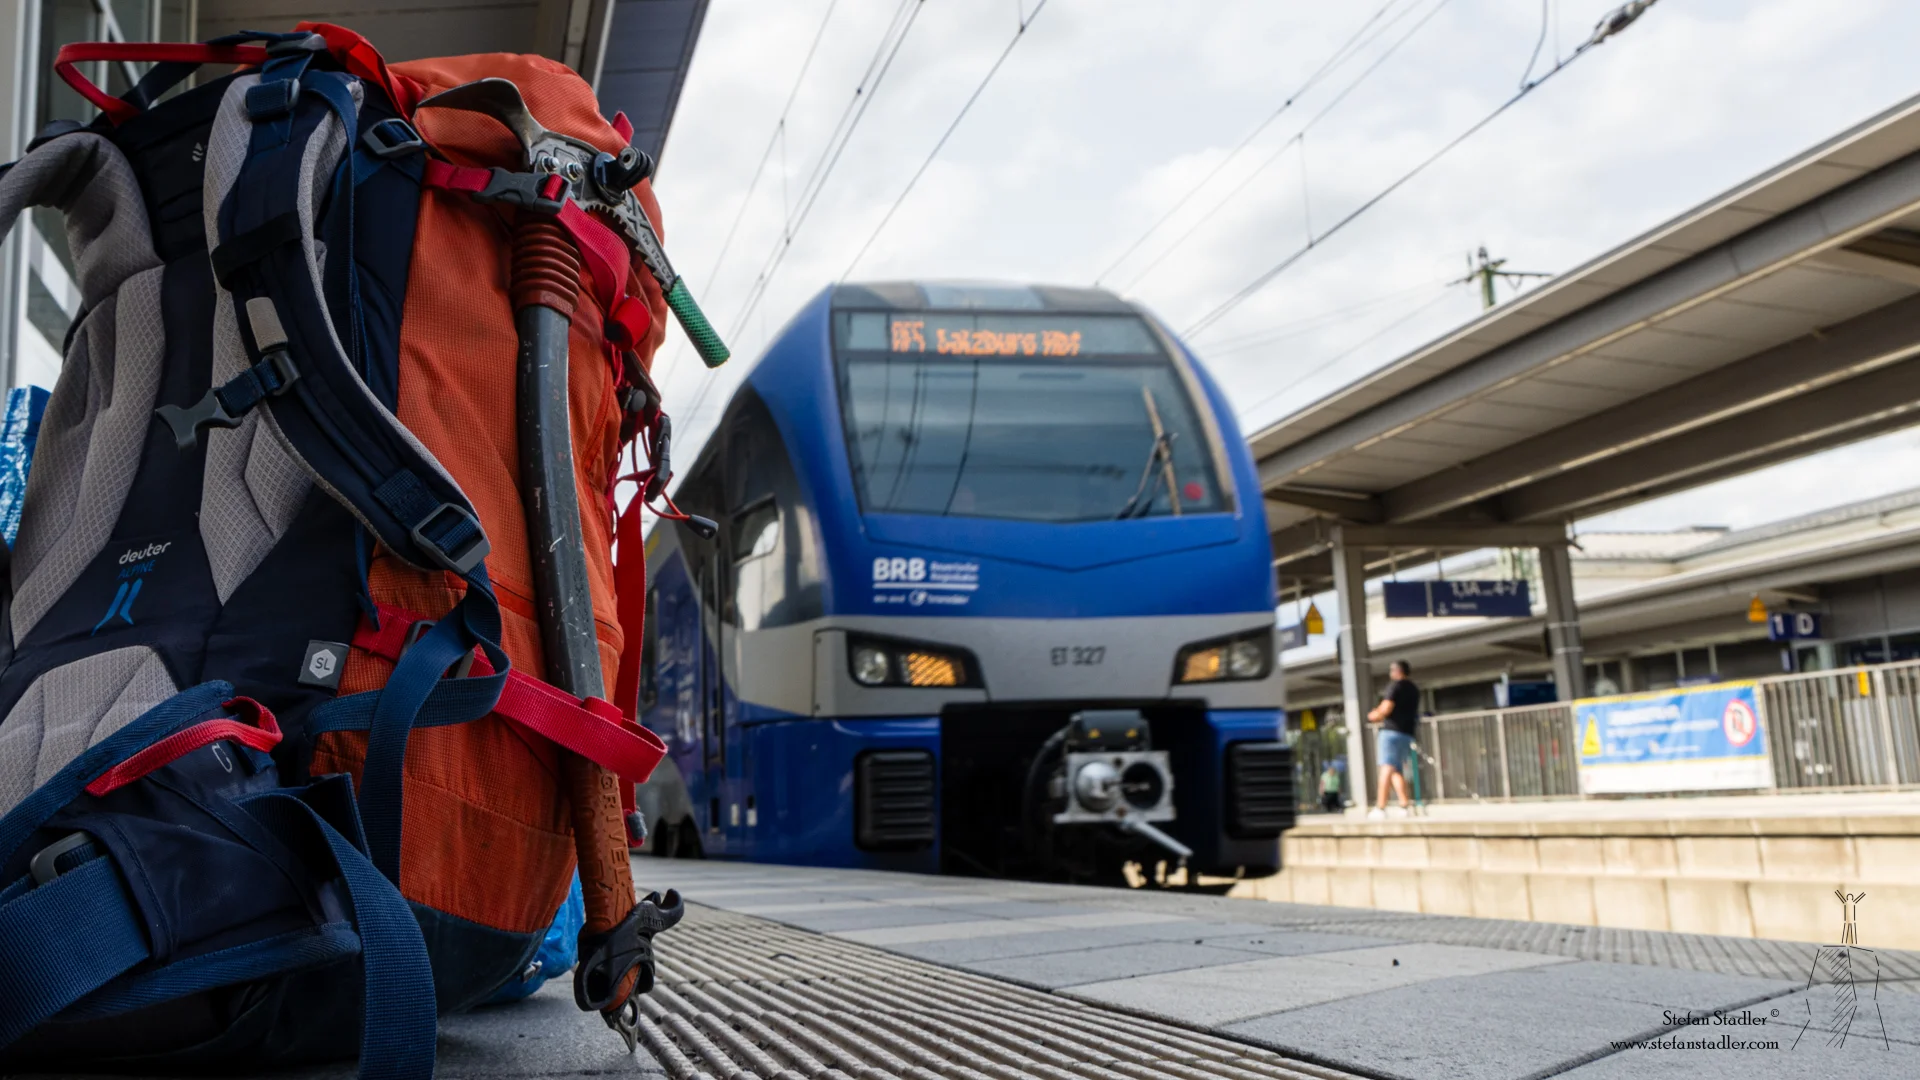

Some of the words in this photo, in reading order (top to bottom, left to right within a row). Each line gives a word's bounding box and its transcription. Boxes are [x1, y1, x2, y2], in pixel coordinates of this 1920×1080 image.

[119, 541, 172, 565] deuter
[872, 557, 927, 581] BRB
[1773, 614, 1785, 636] 1
[1797, 612, 1815, 636] D
[315, 657, 331, 671] SL
[1071, 645, 1107, 667] 327
[601, 774, 630, 884] GRIVEL
